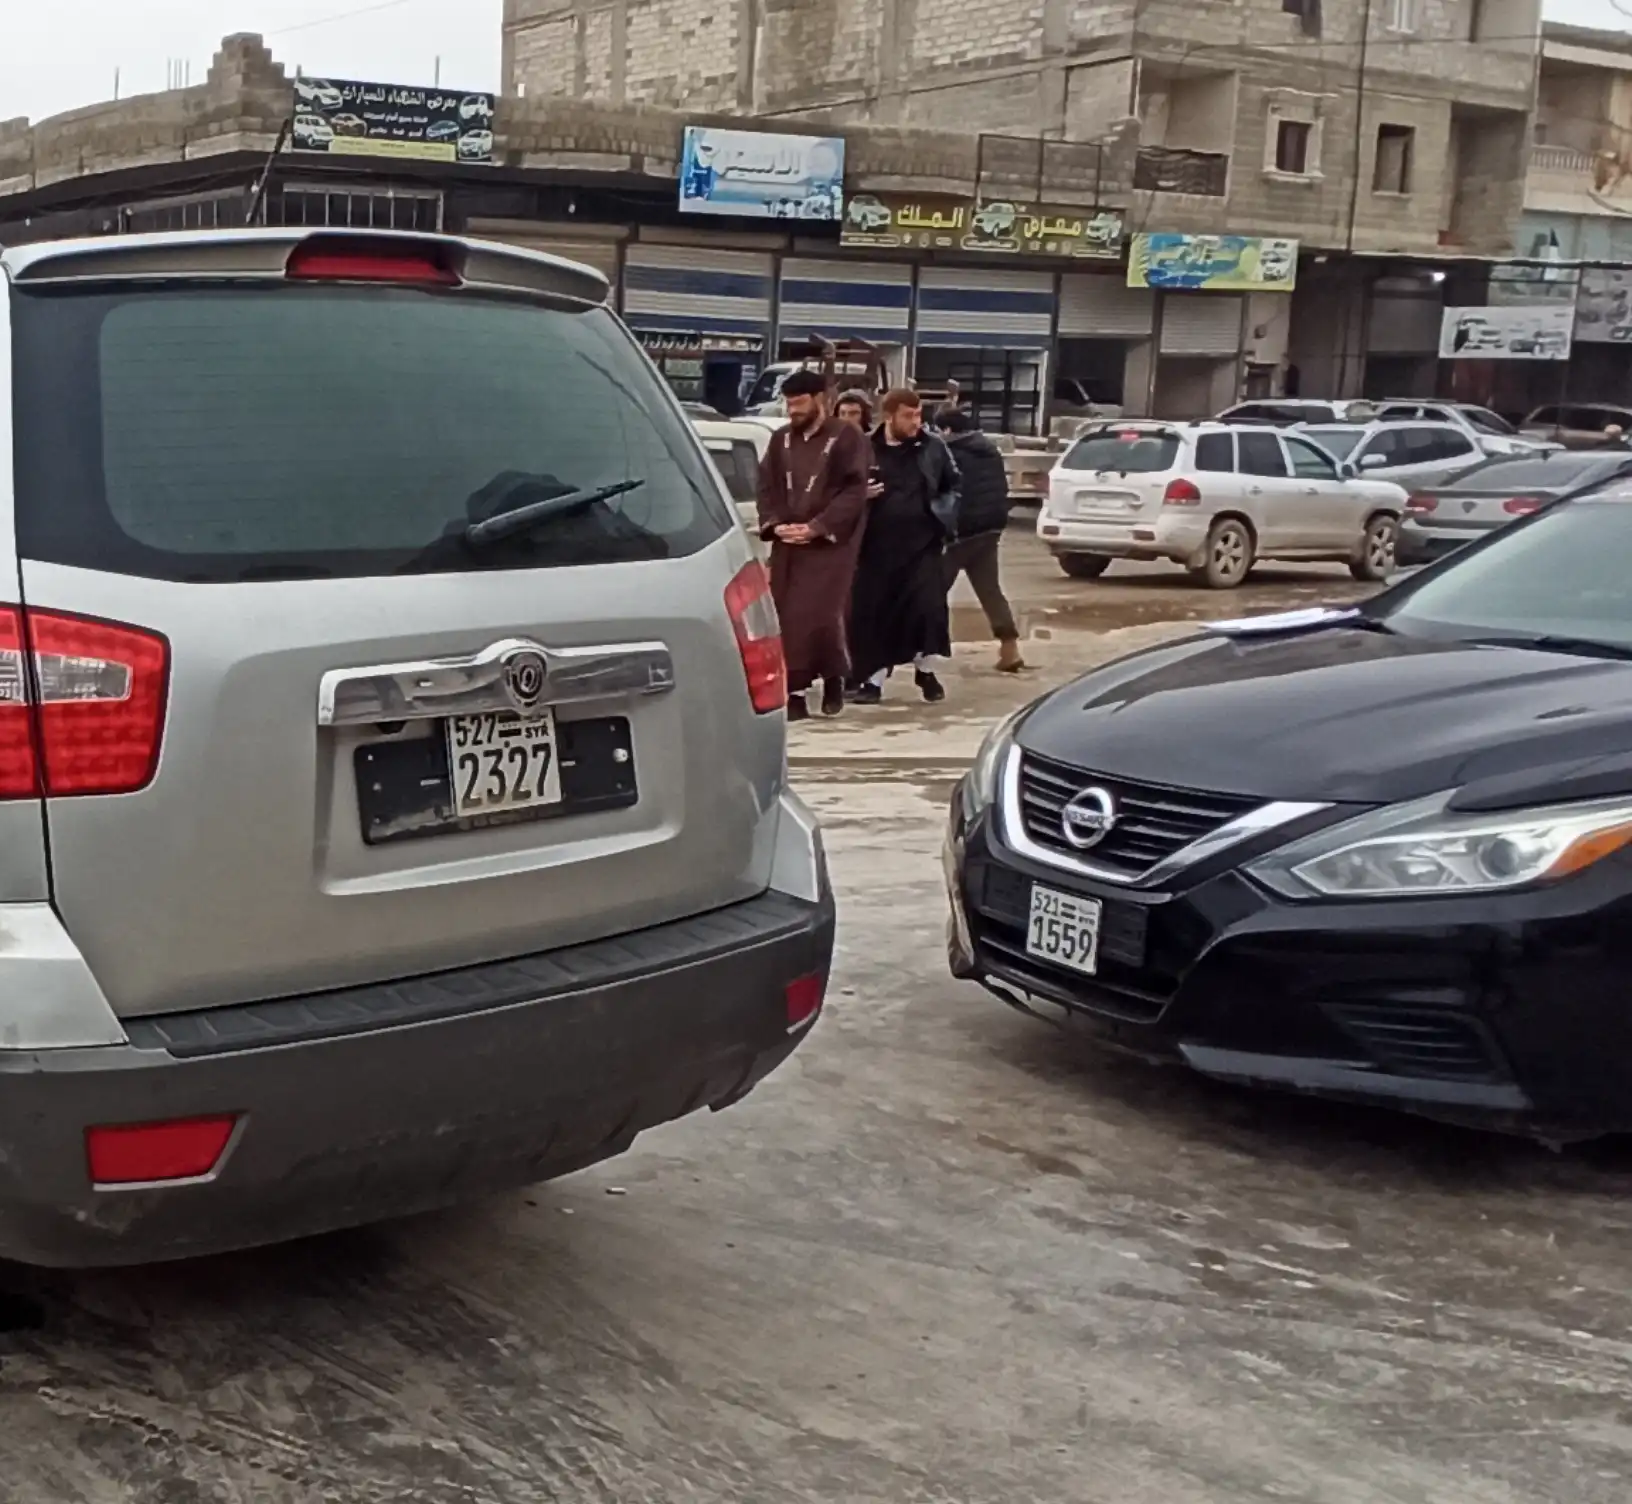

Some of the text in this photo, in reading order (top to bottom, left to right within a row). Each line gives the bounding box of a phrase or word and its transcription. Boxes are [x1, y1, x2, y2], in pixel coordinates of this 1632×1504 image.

[897, 204, 964, 228] الملك
[455, 715, 549, 747] 527 SYR
[459, 743, 552, 809] 2327
[1033, 891, 1059, 916] 521
[1032, 916, 1093, 964] 1559
